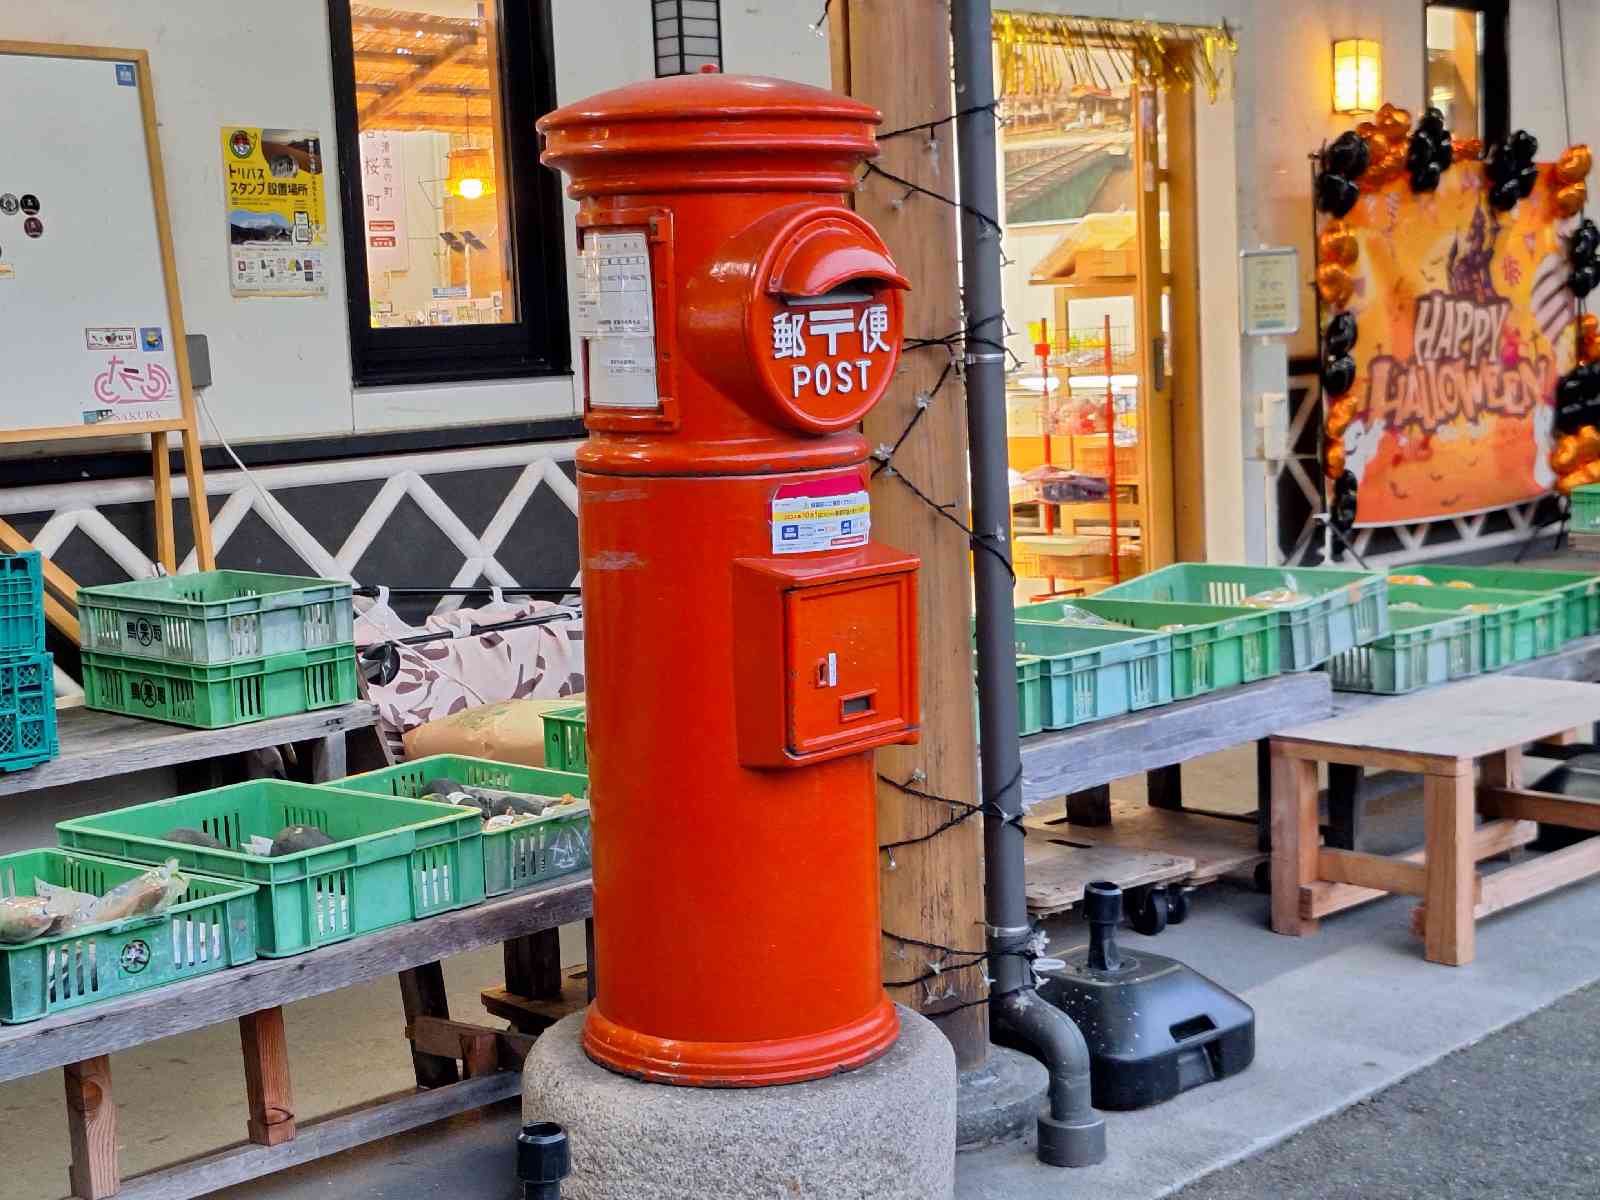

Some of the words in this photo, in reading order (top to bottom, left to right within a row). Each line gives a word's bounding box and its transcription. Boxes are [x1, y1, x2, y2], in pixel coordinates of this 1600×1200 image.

[267, 182, 309, 196] 設置場所
[1414, 296, 1508, 366] HAPPY
[793, 360, 872, 398] POST
[1369, 355, 1552, 430] HALLOWEEN
